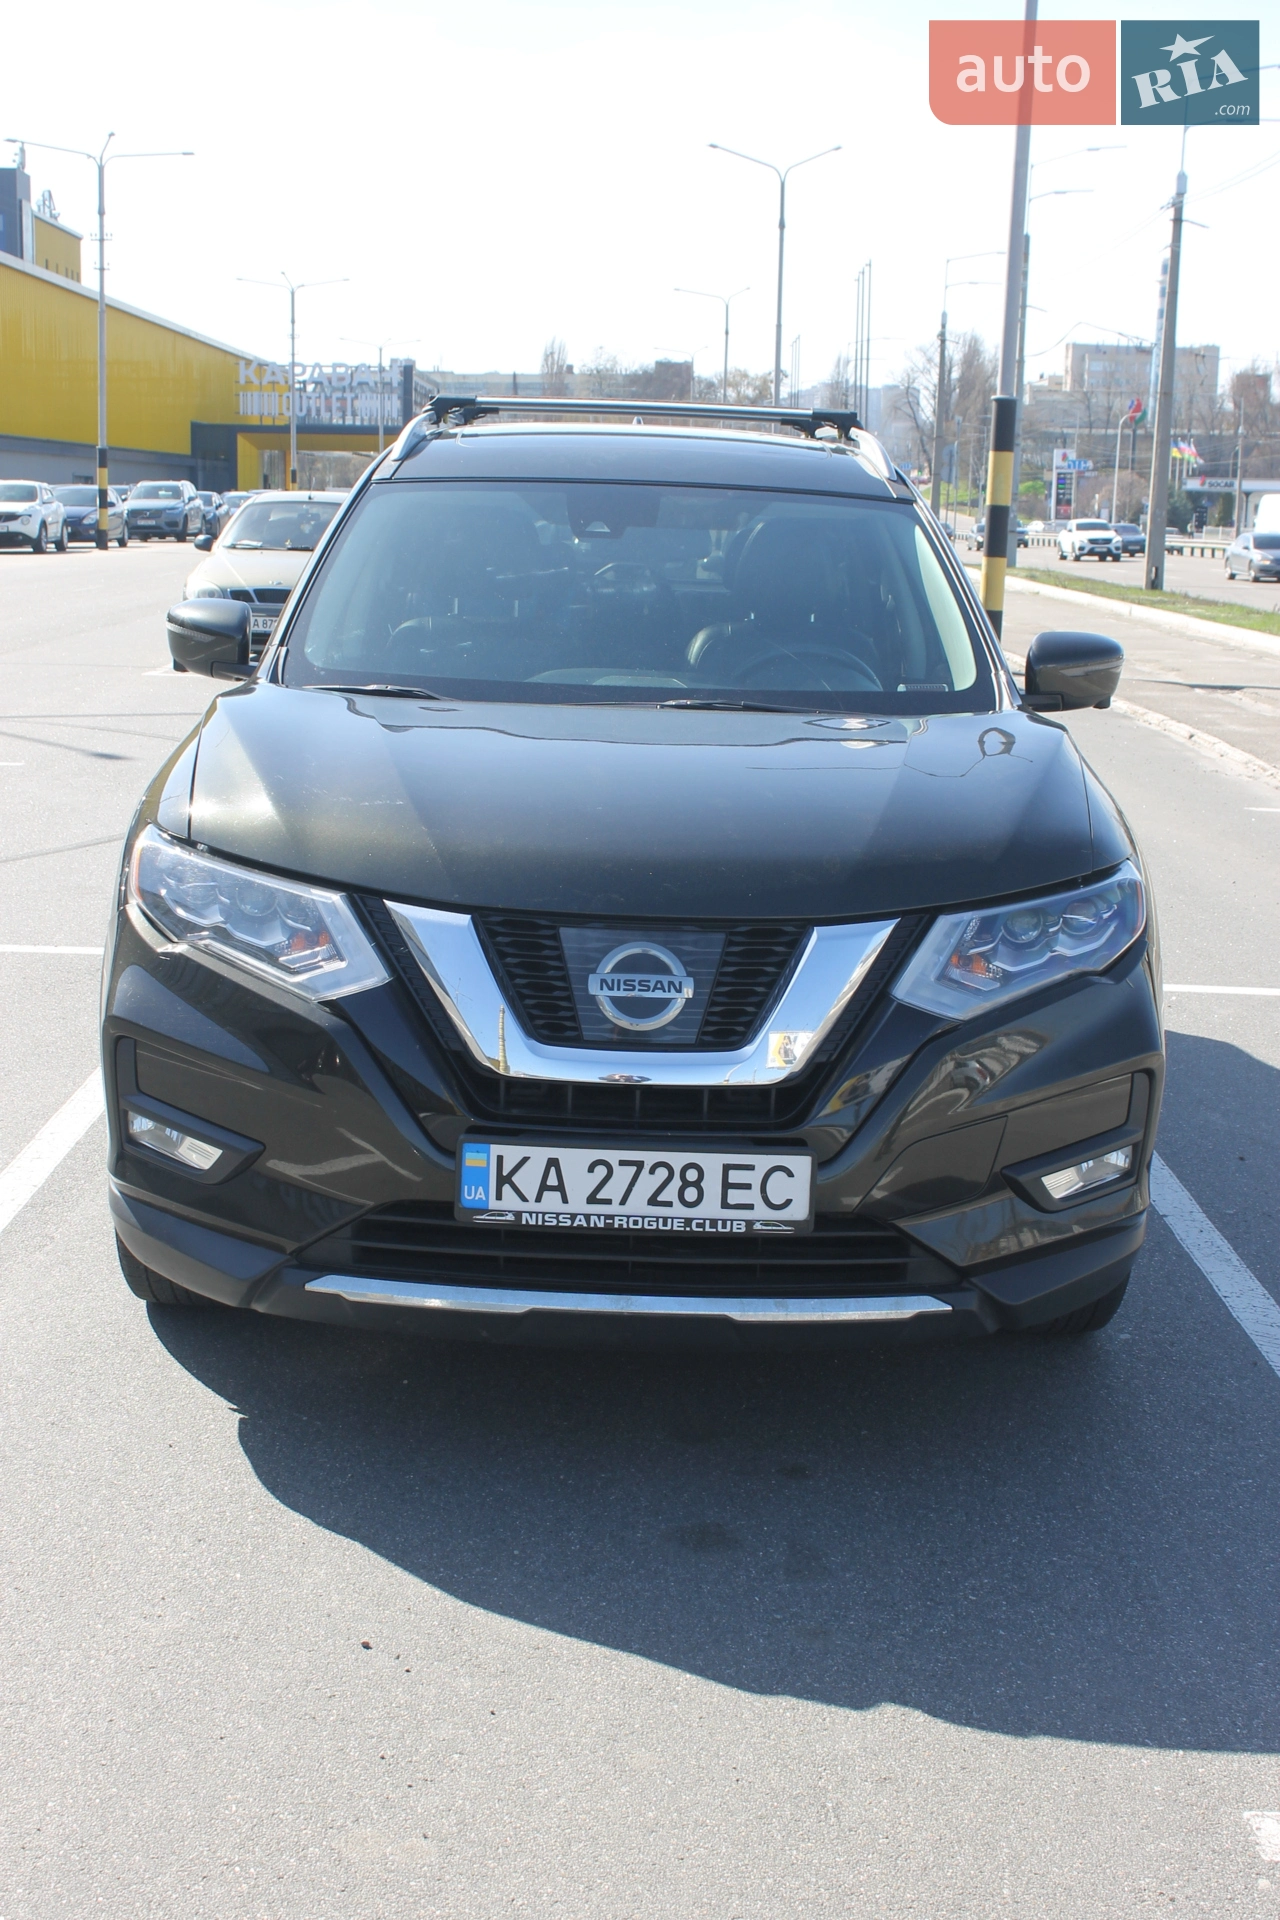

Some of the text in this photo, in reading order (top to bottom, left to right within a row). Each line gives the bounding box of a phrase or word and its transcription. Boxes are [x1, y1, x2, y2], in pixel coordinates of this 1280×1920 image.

[282, 391, 355, 418] OUTLET
[1208, 480, 1235, 488] SOCAR
[600, 978, 682, 993] NISSAN
[495, 1154, 795, 1211] KA 2728 EC
[464, 1185, 486, 1201] UA
[521, 1212, 746, 1233] NISSAN-ROGUE.CLUB
